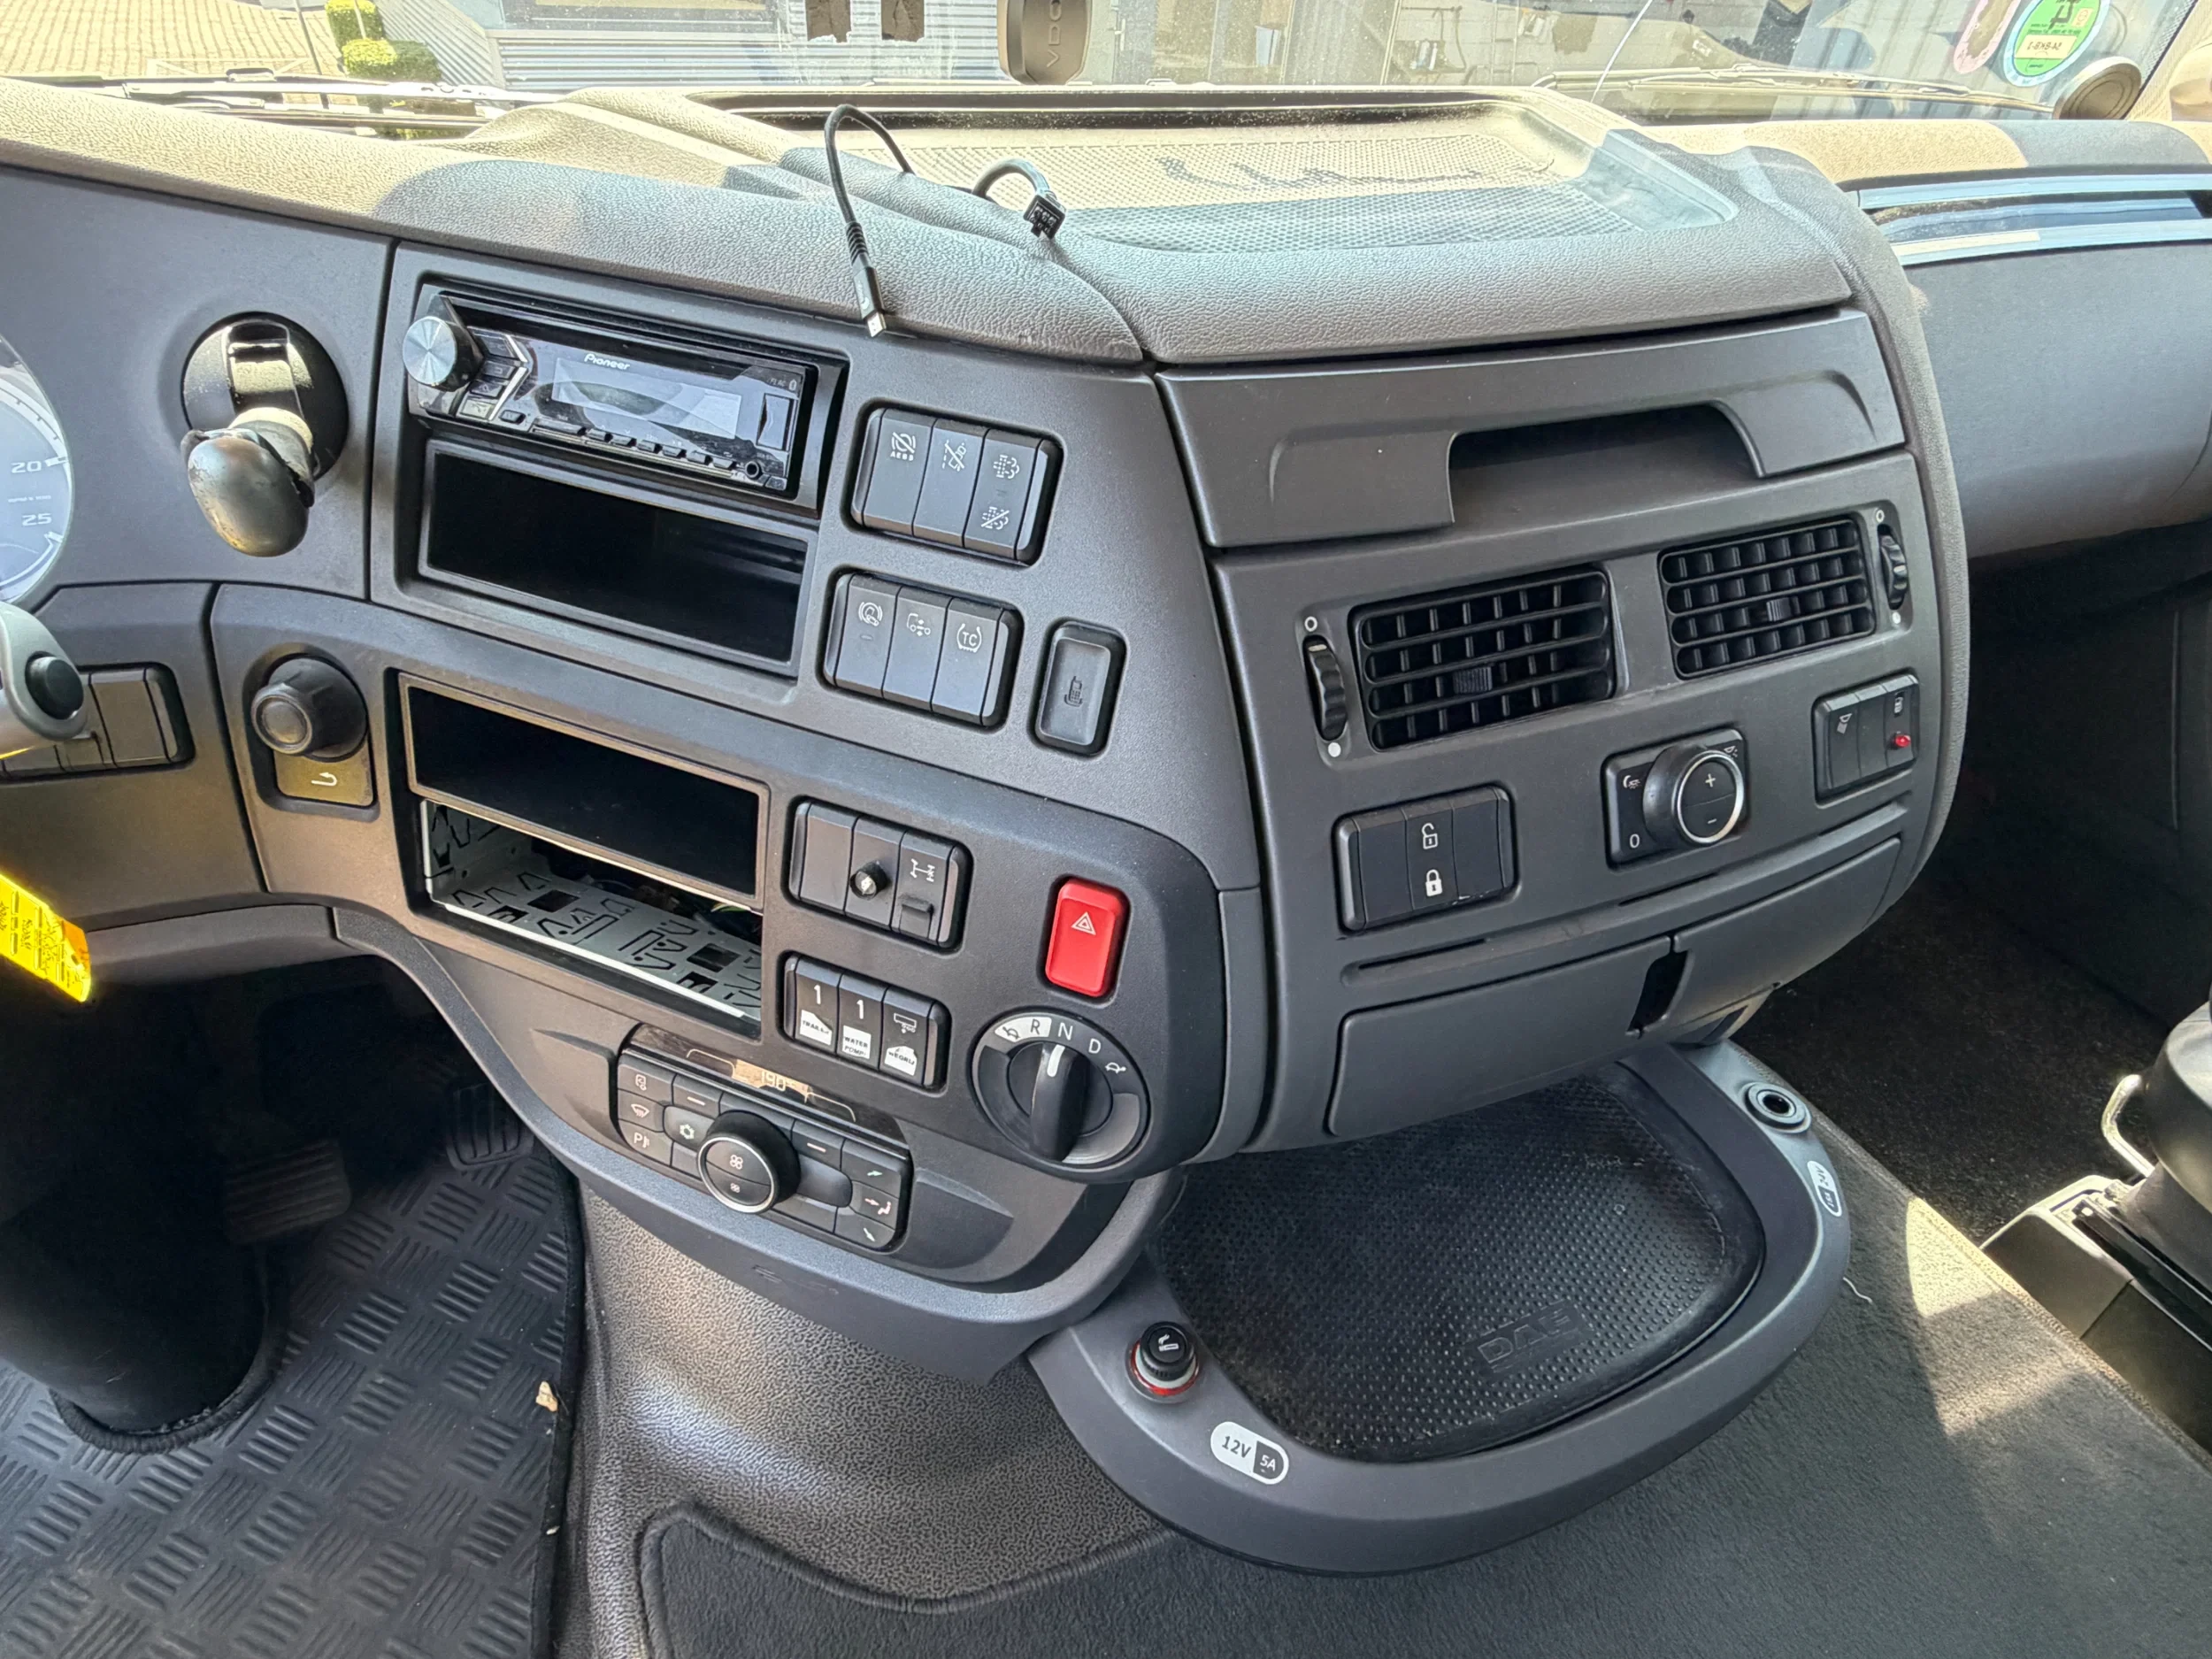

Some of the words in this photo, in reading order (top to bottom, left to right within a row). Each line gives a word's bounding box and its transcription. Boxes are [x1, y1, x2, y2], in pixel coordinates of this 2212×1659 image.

[1047, 0, 1062, 68] VDO
[584, 353, 631, 370] Pioneer
[11, 460, 42, 473] 20
[22, 512, 52, 526] 25
[963, 631, 979, 647] TC
[813, 984, 821, 1005] 1
[856, 999, 864, 1020] 1
[844, 1036, 868, 1048] WATER
[1030, 1018, 1041, 1035] R
[1057, 1022, 1073, 1041] N
[1088, 1038, 1102, 1054] D
[1477, 1308, 1571, 1364] DAF
[1221, 1435, 1252, 1458] 12V
[1259, 1454, 1277, 1471] 5A
